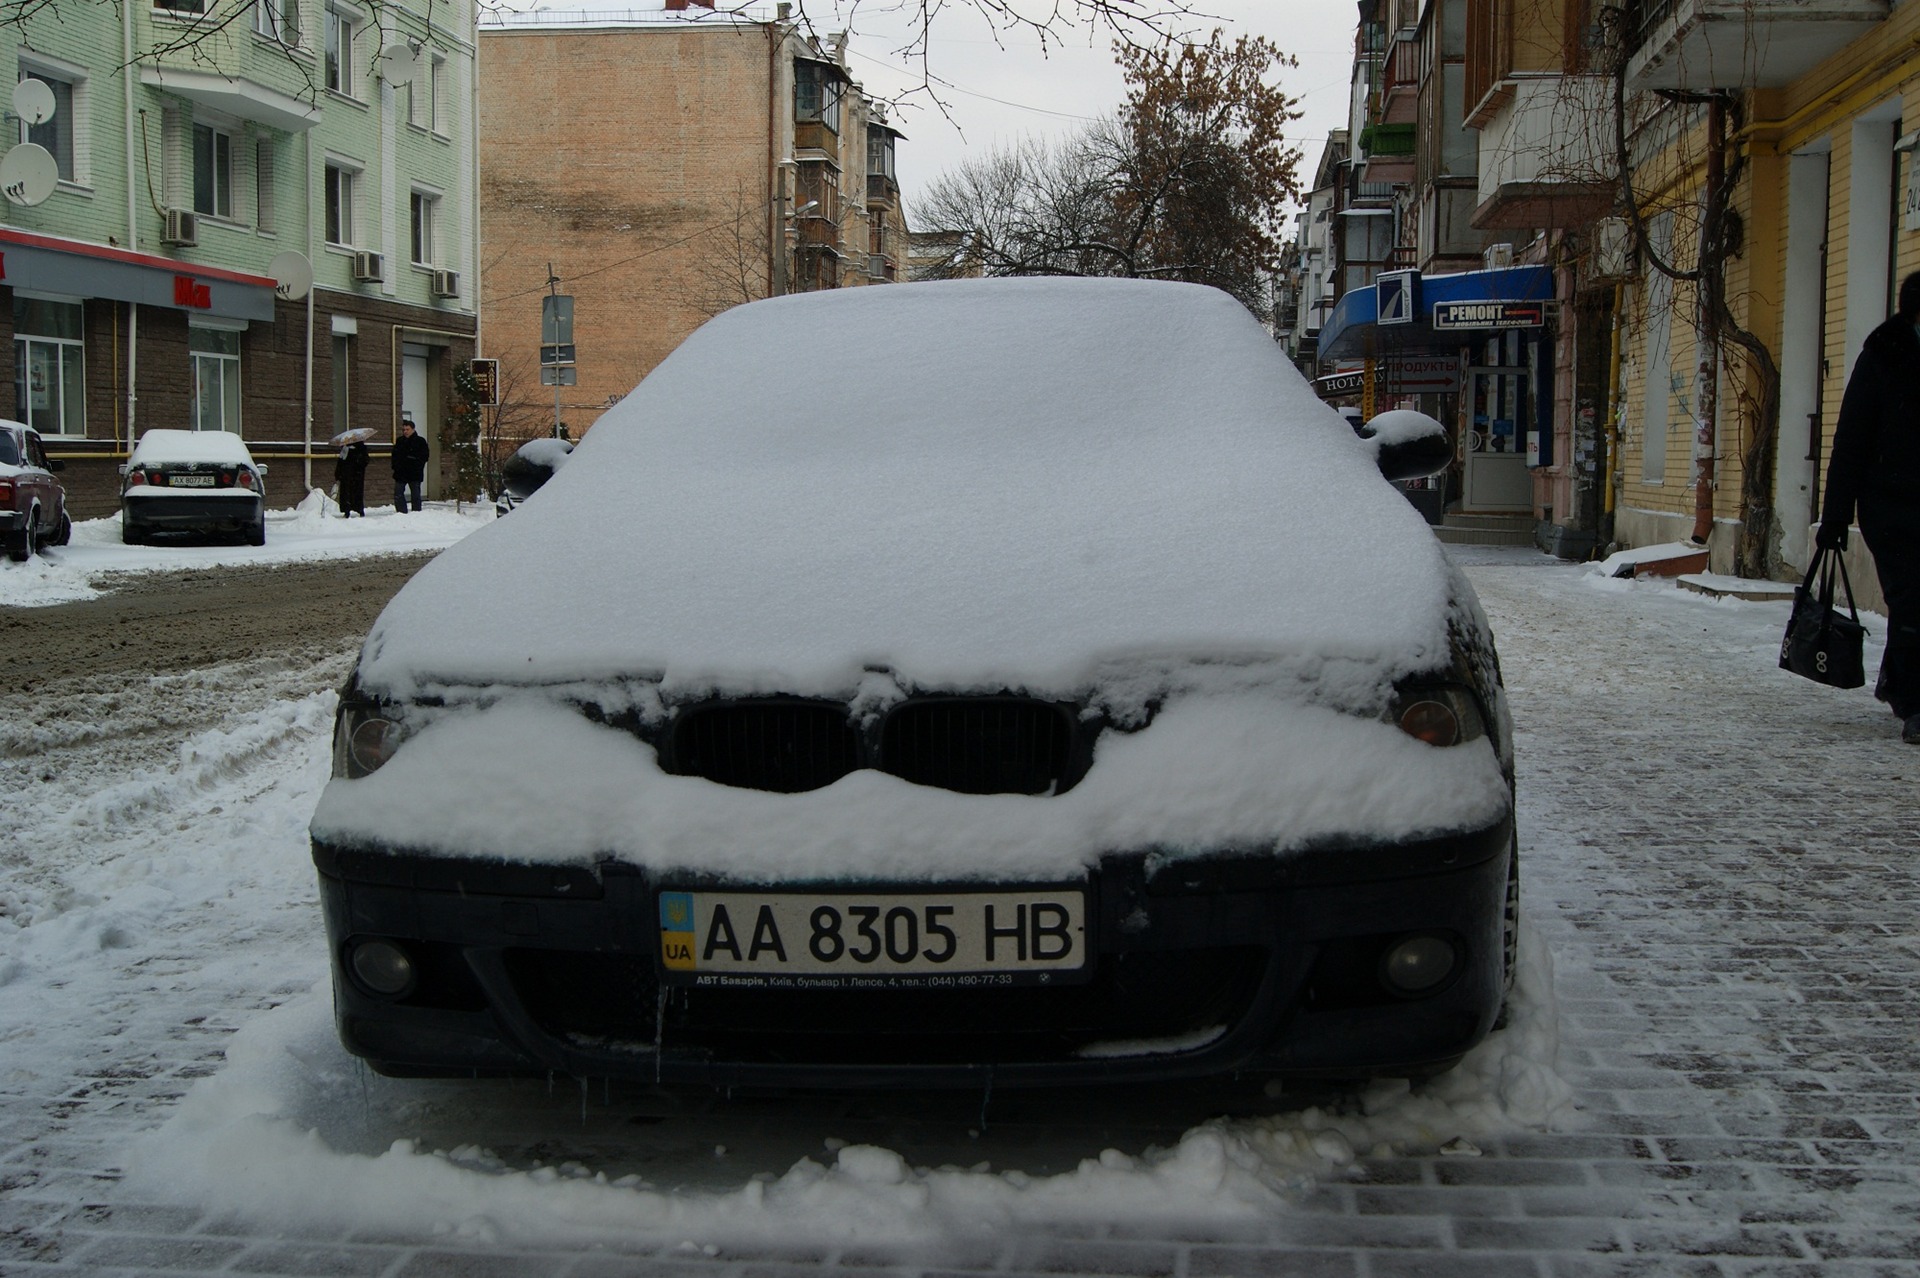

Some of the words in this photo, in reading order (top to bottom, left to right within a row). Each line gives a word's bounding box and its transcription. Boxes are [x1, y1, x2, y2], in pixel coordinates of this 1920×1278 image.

[1449, 305, 1503, 321] РЕМОНТ
[1387, 361, 1458, 373] ПРОДУКТЫ
[174, 475, 184, 484] AX
[185, 475, 202, 484] 8077
[203, 475, 213, 484] AE
[703, 903, 787, 962] AA
[809, 905, 957, 963] 8305
[984, 903, 1073, 962] HB
[665, 944, 691, 960] UA
[696, 976, 718, 985] АВТ
[720, 976, 767, 988] Баварія,
[769, 976, 795, 987] Київ,
[797, 977, 839, 989] бульвар
[850, 978, 886, 988] Лепсе,
[888, 978, 899, 988] 4,
[901, 978, 926, 987] тел.:
[928, 975, 955, 987] (044)
[957, 974, 1013, 986] 490-77-33
